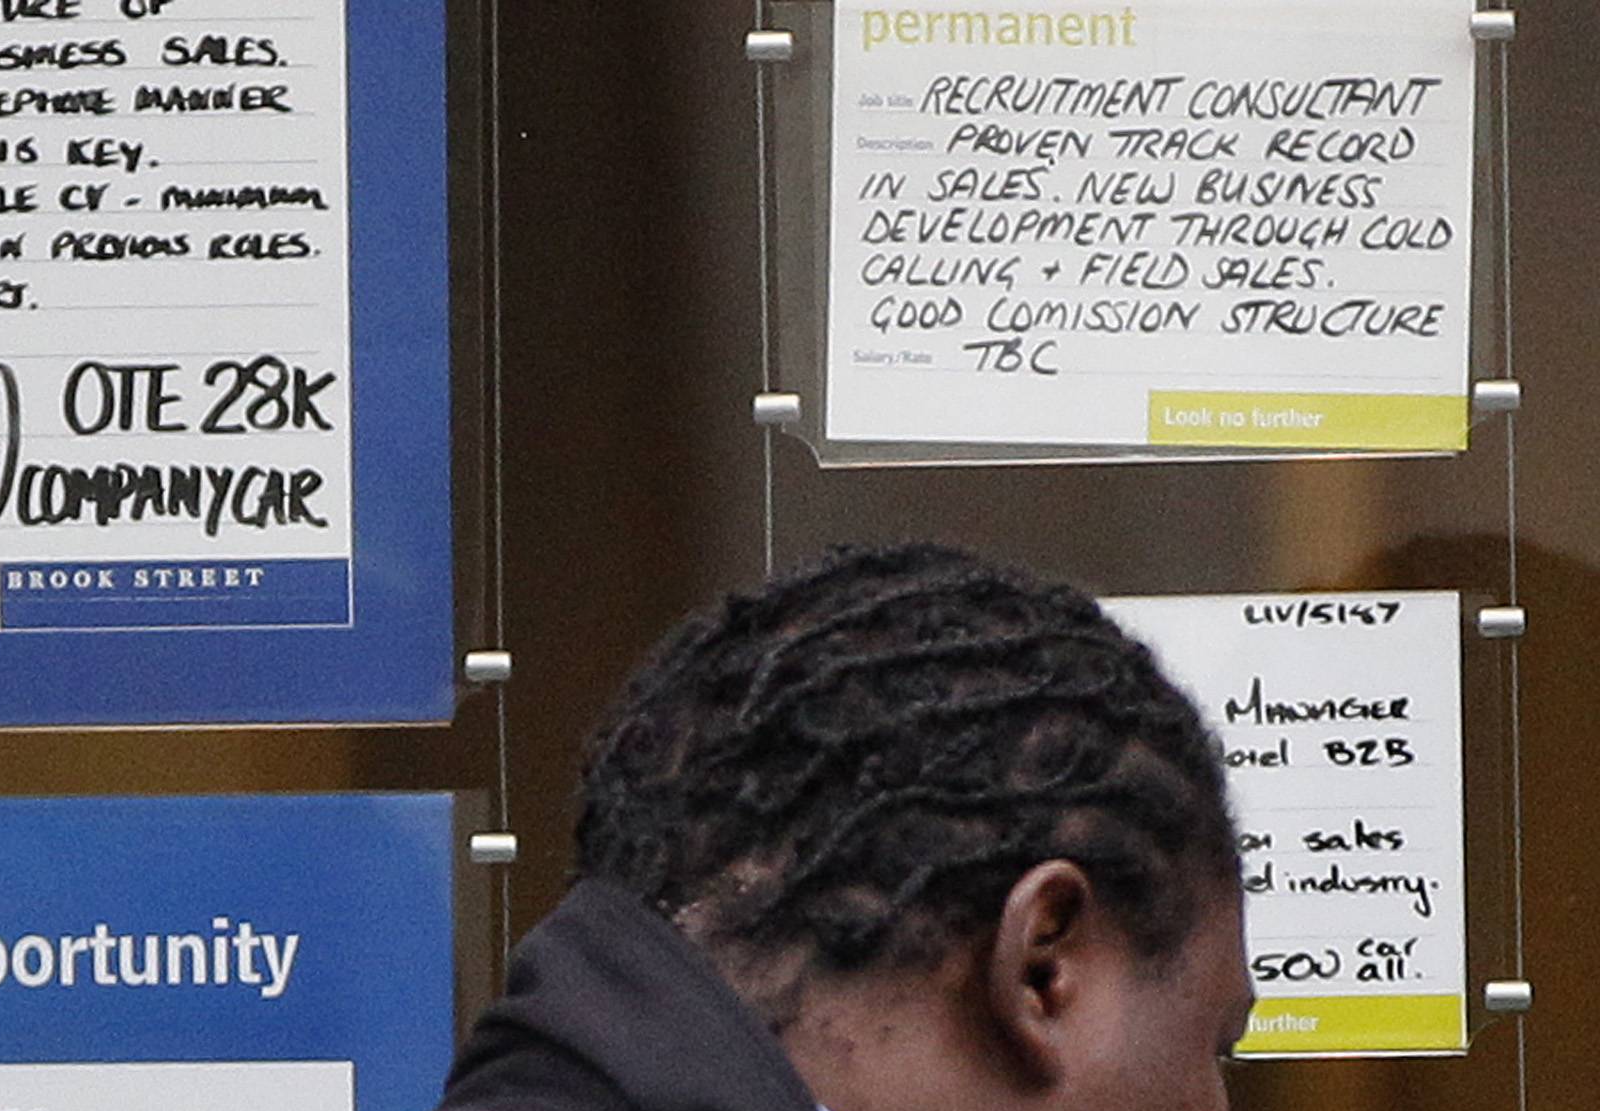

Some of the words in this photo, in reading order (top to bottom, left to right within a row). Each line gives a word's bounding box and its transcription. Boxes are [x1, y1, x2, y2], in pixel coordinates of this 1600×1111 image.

[864, 10, 1136, 48] permanent
[162, 35, 287, 67] SALES.
[135, 84, 292, 113] MANNER
[920, 75, 1184, 118] RECRUITMENT
[1189, 78, 1442, 120] CONSULTANT
[67, 139, 159, 173] KEY.
[947, 123, 1092, 165] PROVEN
[1109, 129, 1238, 160] TRACK
[1266, 127, 1414, 164] RECORD
[60, 184, 108, 212] CV
[859, 173, 906, 200] IN
[1076, 172, 1174, 205] NEW
[1195, 168, 1382, 208] BUSINESS
[862, 207, 1156, 246] DEVELOPMENT
[1171, 213, 1349, 250] THROUGH
[1360, 215, 1452, 250] COLD
[862, 254, 1020, 291] CALLING
[1080, 251, 1189, 290] FIELD
[1202, 256, 1333, 290] SALES.
[871, 296, 962, 333] GOOD
[988, 297, 1200, 333] COMISSION
[1221, 300, 1444, 337] STRUCTURE
[963, 337, 1057, 375] TBC
[64, 362, 188, 436] OTE
[201, 355, 336, 434] 28K
[1165, 408, 1211, 426] Look
[1220, 412, 1245, 426] no
[1252, 409, 1323, 427] further
[8, 570, 113, 588] BROOK
[135, 569, 263, 587] STREET
[1303, 820, 1403, 852] sales
[1357, 938, 1417, 957] car
